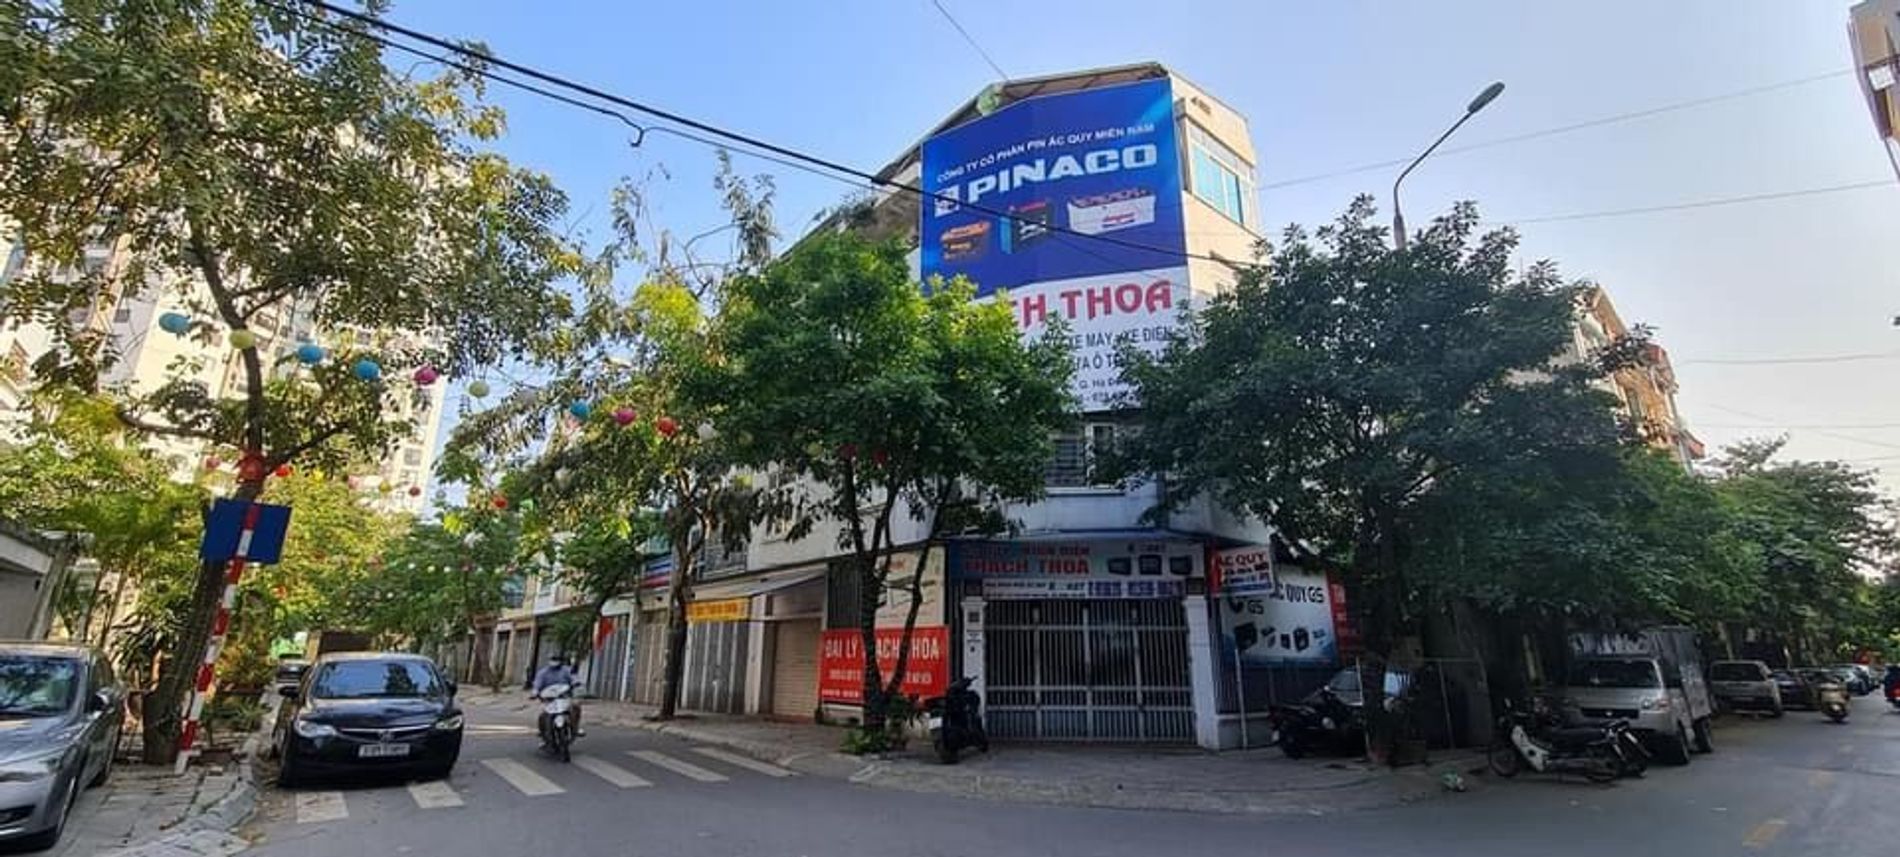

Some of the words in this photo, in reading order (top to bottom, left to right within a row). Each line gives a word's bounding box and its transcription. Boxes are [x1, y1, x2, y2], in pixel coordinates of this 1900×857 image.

[965, 160, 979, 172] TY
[1026, 139, 1046, 151] PIN
[967, 143, 1158, 205] PINACO
[1060, 280, 1173, 321] THOA
[911, 636, 940, 661] HOA
